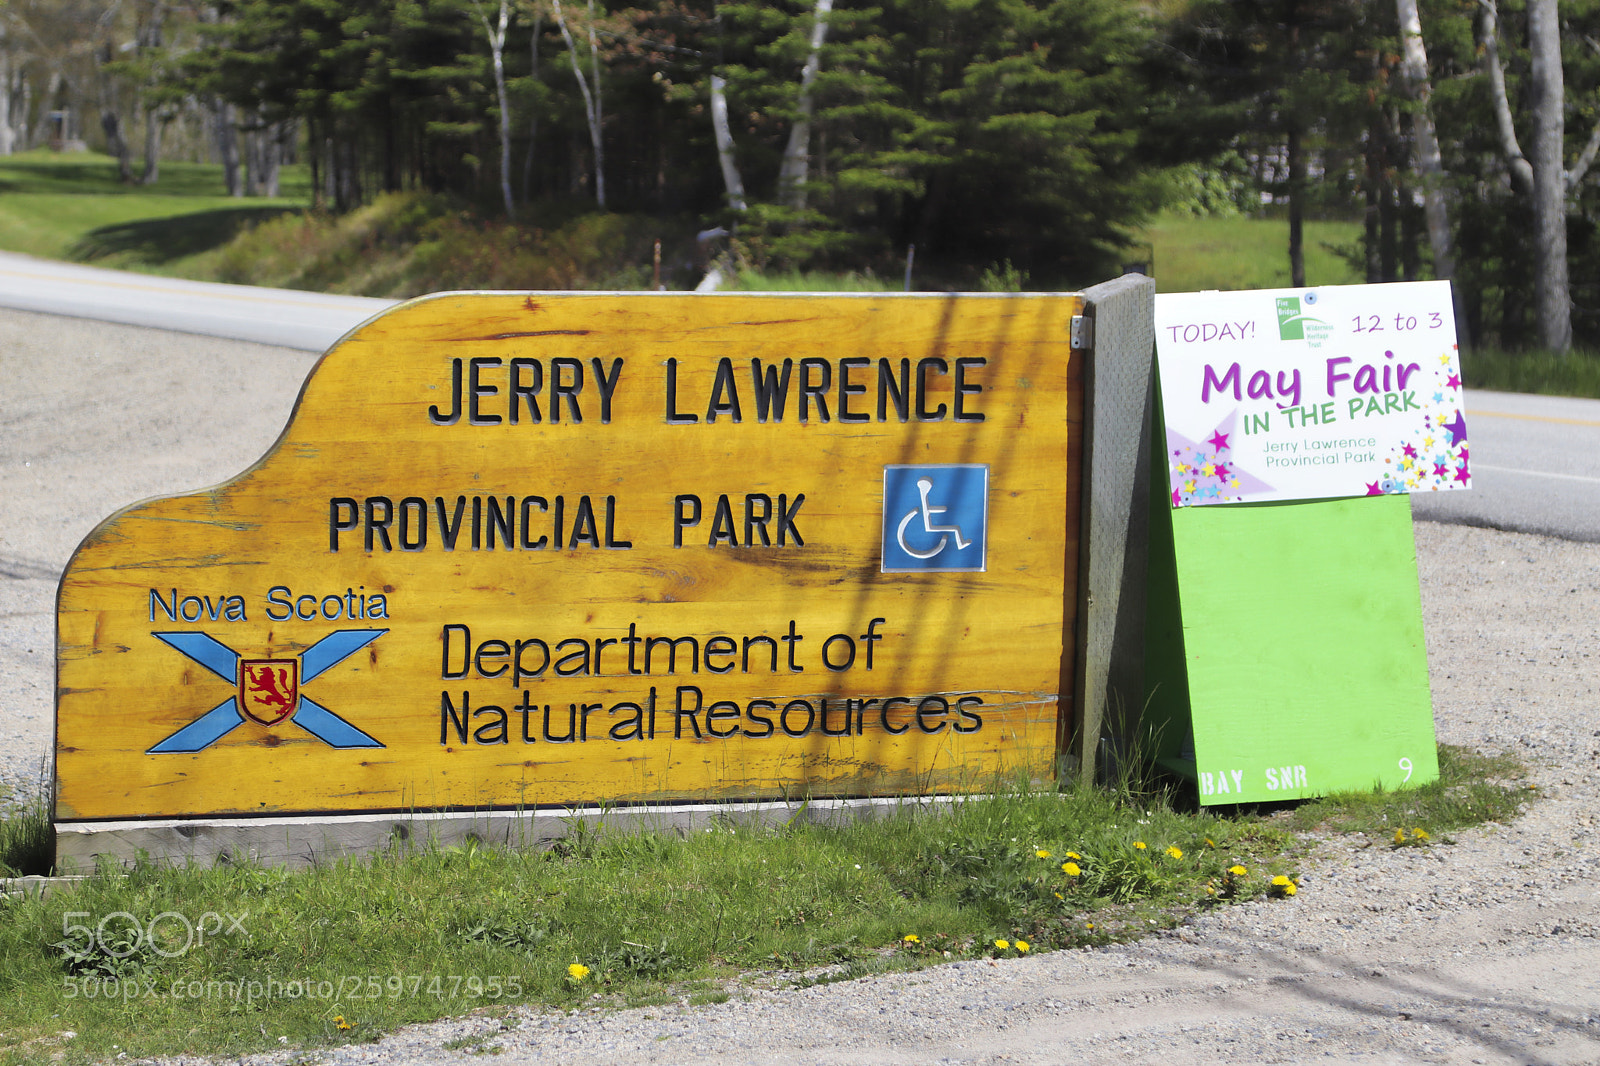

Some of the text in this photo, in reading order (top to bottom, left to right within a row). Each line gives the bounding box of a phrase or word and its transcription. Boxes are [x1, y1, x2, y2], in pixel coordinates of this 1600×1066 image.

[1166, 320, 1255, 343] TODAY!
[1278, 308, 1299, 316] Bridges
[1352, 312, 1443, 333] 12 to 3
[428, 356, 988, 426] JERRY LAWRENCE
[1201, 350, 1421, 410] May Fair
[1244, 390, 1421, 435] IN THE PARK
[1263, 437, 1376, 453] Jerry Lawrence
[1266, 451, 1376, 467] Provincial Park
[330, 493, 806, 553] PROVINCIAL PARK
[149, 585, 390, 622] Nova Scotia
[442, 617, 886, 688] Department of
[441, 685, 984, 745] Natural Resources
[1199, 757, 1413, 796] BAY SNR 9
